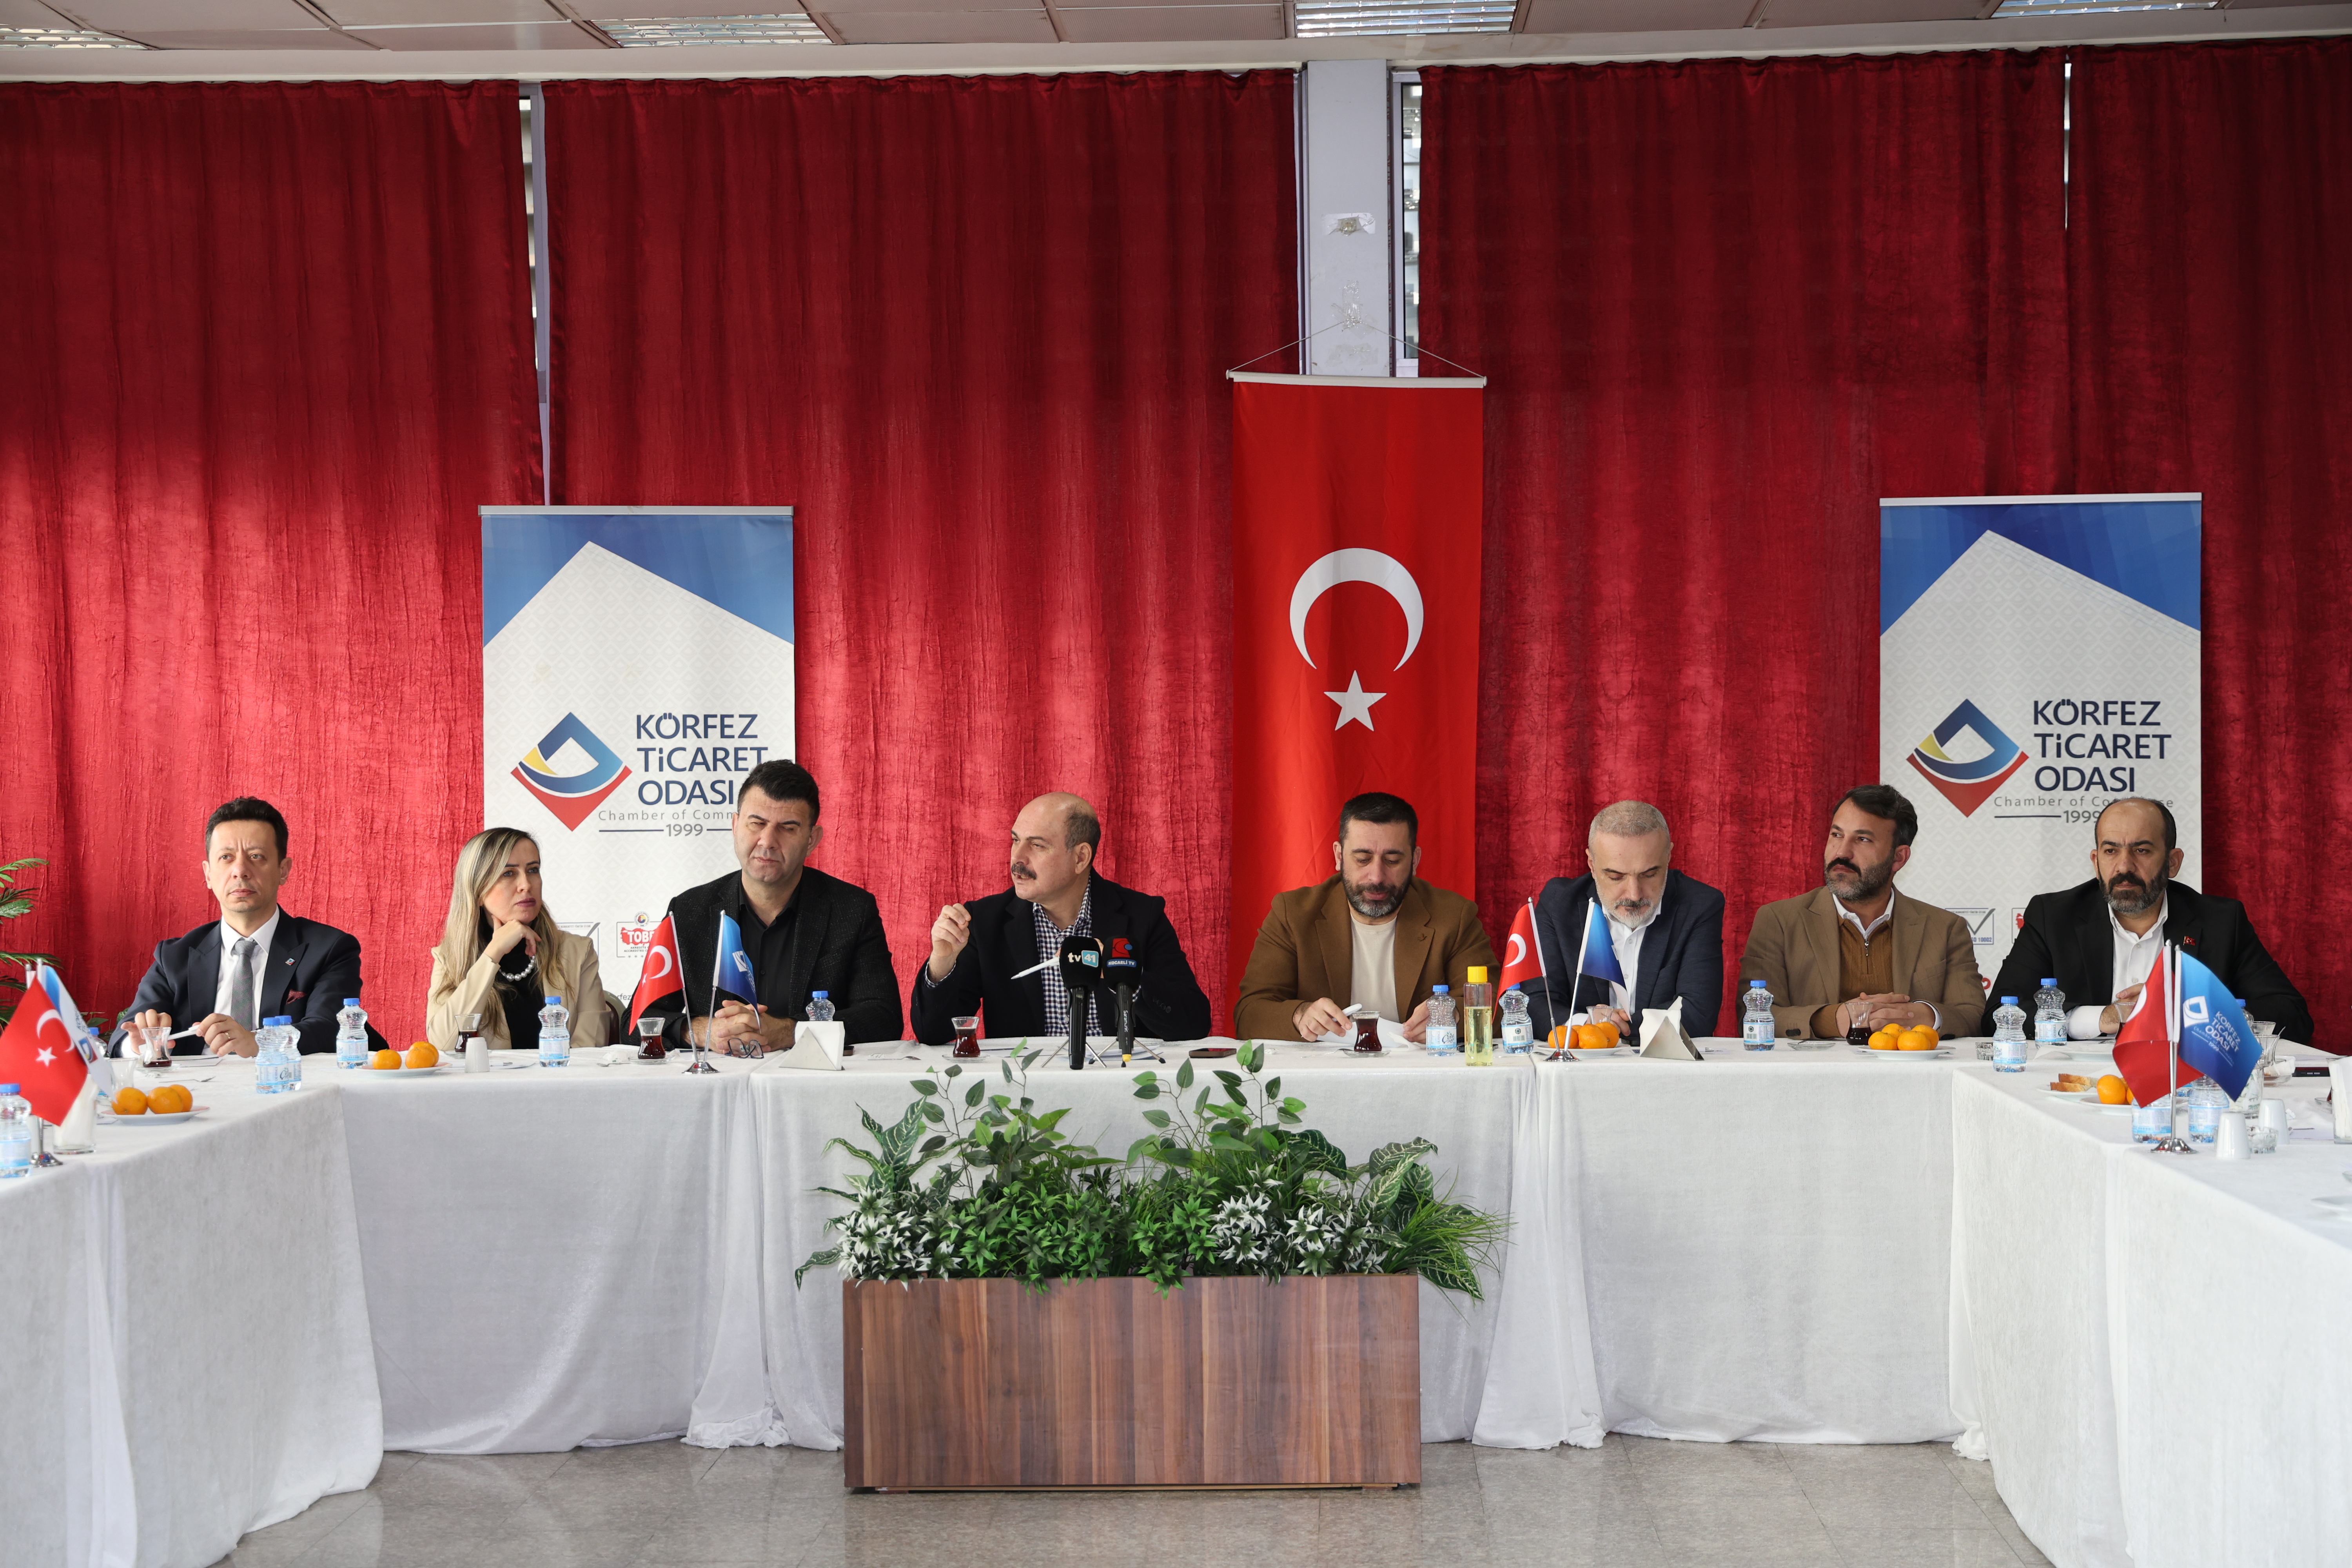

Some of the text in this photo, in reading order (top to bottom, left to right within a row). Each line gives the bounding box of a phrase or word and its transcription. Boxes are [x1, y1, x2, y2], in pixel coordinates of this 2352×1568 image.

[2034, 699, 2161, 726] KÖRFEZ
[637, 713, 758, 739] KÖRFEZ
[2034, 766, 2135, 792] ODASI
[638, 780, 734, 805] ODASI
[1994, 796, 2063, 807] Chamber
[2070, 796, 2085, 806] of
[599, 809, 739, 820] Chamber of Comm
[2063, 810, 2100, 824] 1999
[666, 824, 703, 837] 1999
[1068, 952, 1096, 963] tv 41
[2205, 1025, 2230, 1051] ODASI
[2209, 1041, 2219, 1051] 1999
